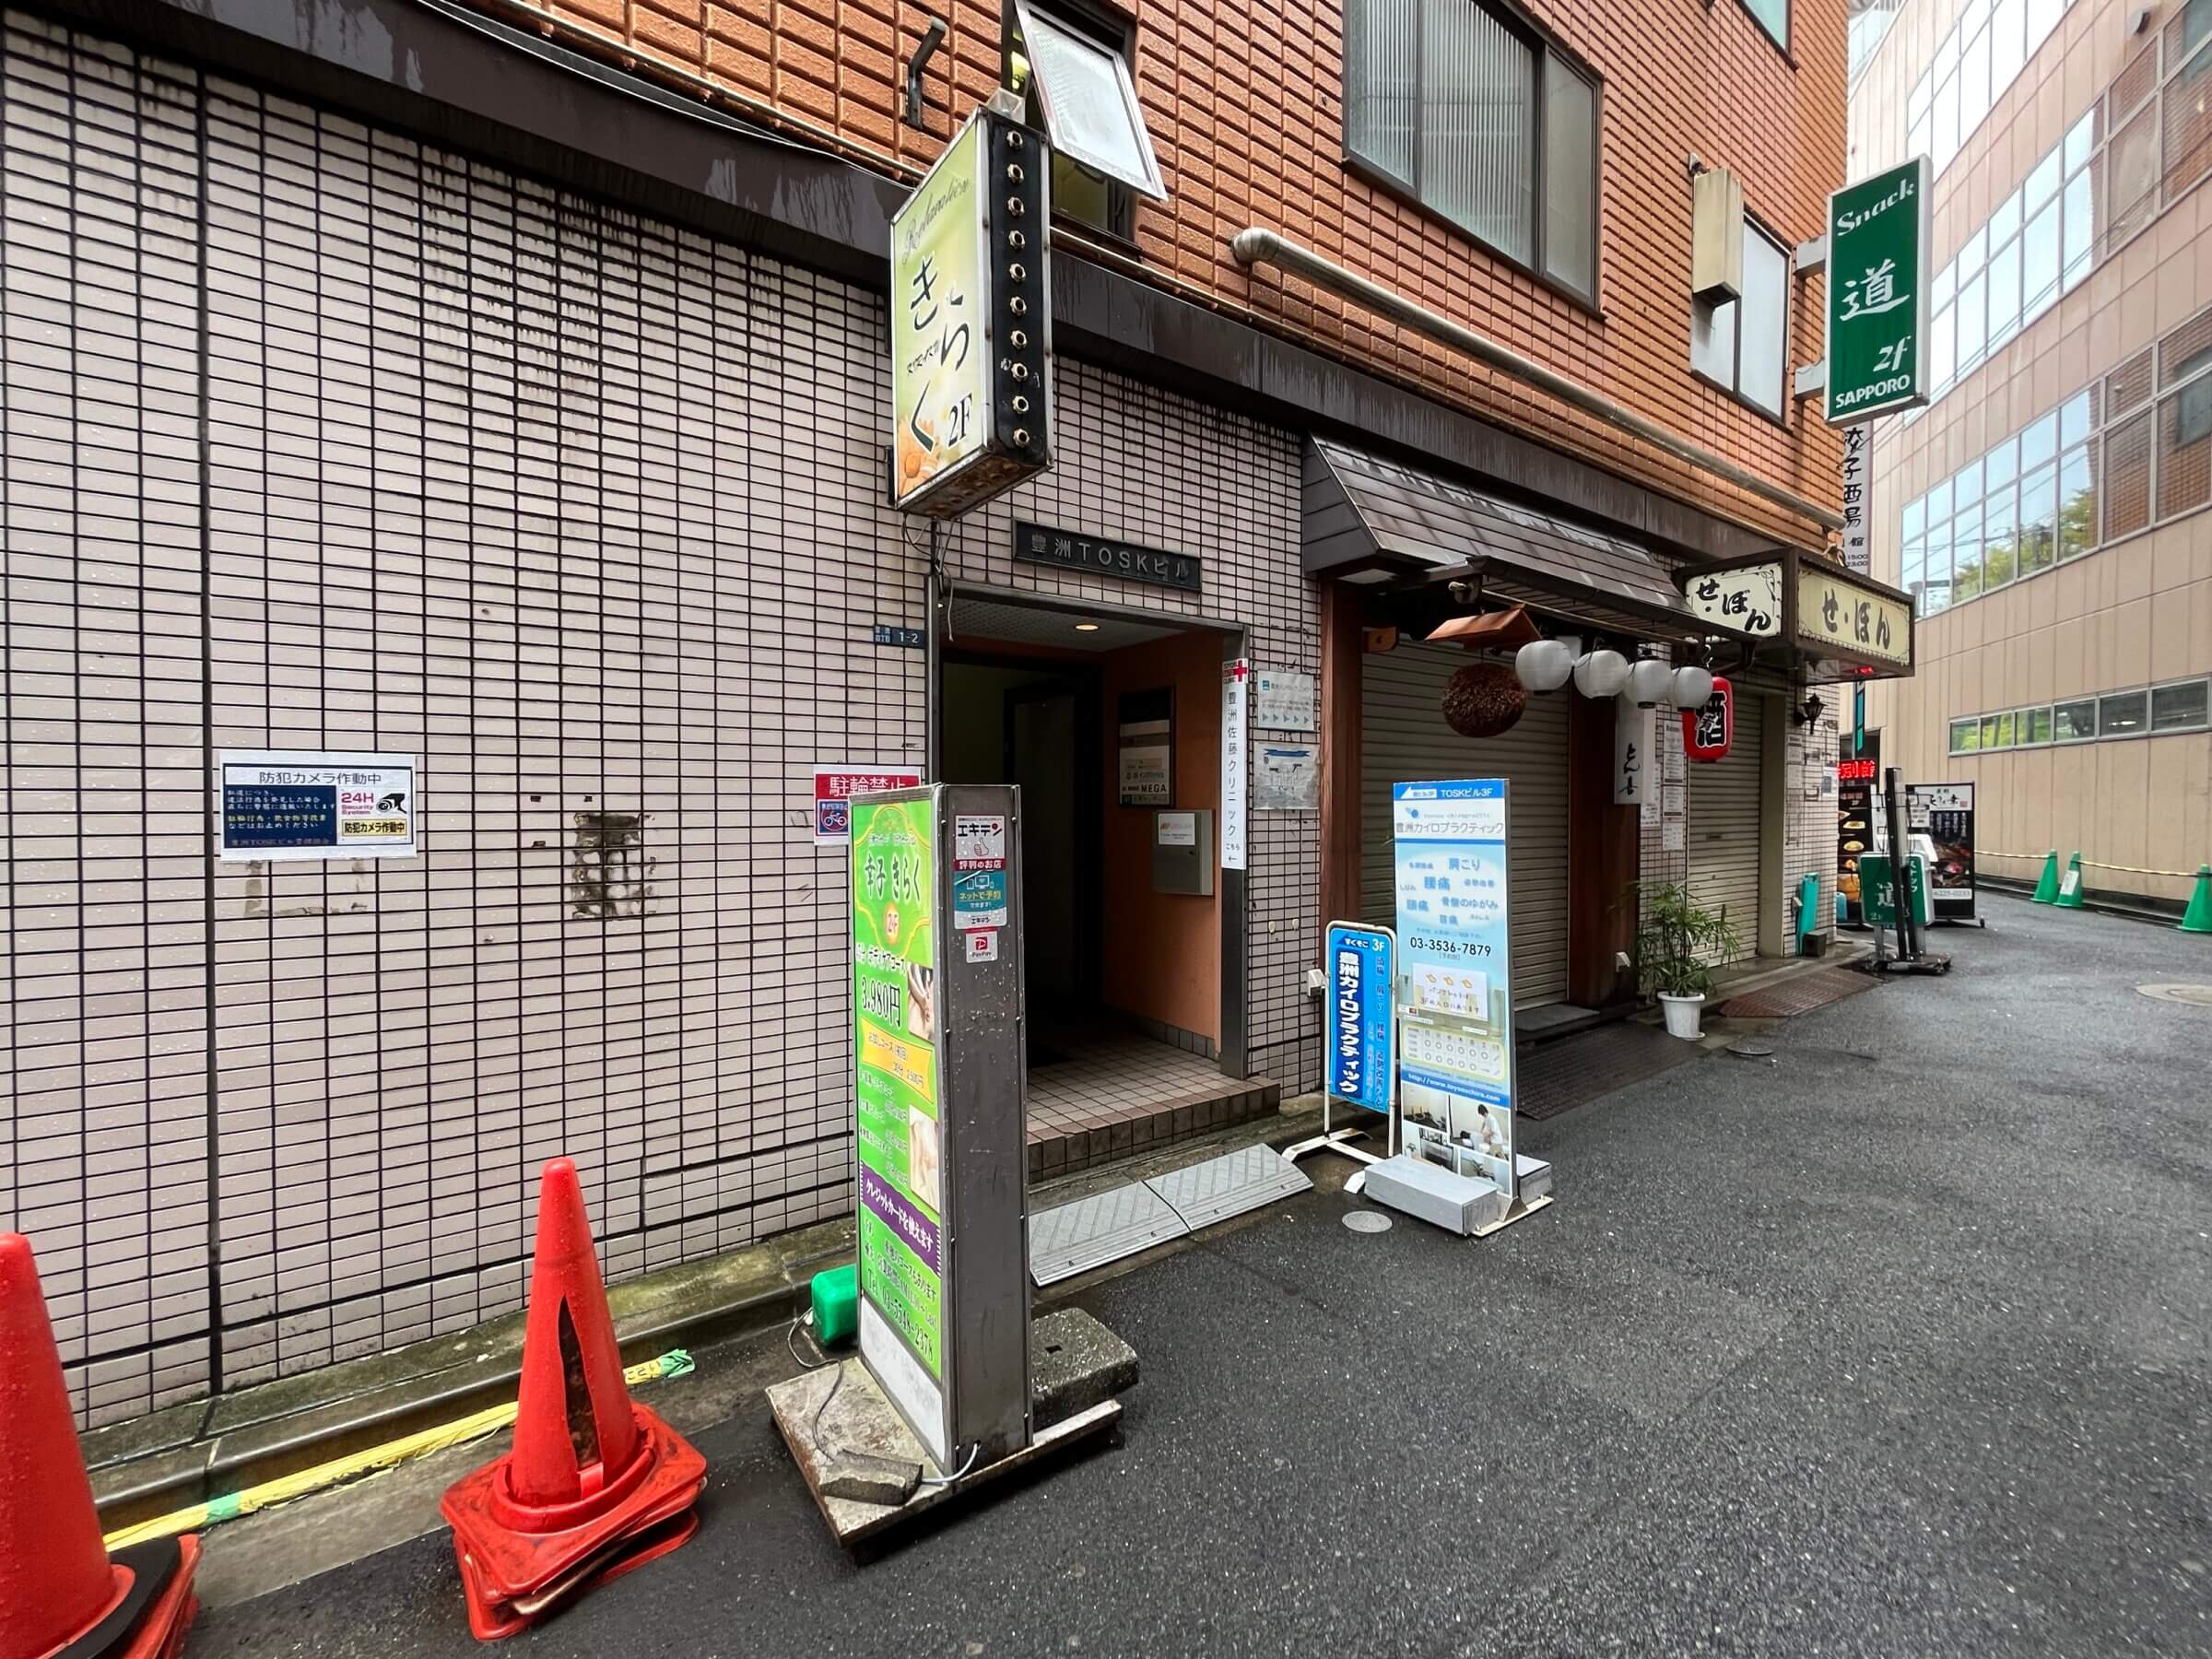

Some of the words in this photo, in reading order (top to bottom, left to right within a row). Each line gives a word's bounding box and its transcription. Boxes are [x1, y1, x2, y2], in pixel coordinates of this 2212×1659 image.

[1837, 178, 1914, 238] Snack
[1840, 258, 1910, 322] 道
[1835, 374, 1911, 408] SAPPORO
[948, 393, 972, 447] 2F
[899, 631, 918, 643] 1-2
[1227, 692, 1239, 837] 豊洲佐藤クリニック
[258, 771, 382, 784] 防犯カメラ作動中
[830, 776, 906, 797] 駐輪禁止
[1141, 783, 1167, 793] MEGA
[1440, 787, 1493, 798] TOSKビル3F
[341, 793, 374, 803] 24H
[344, 822, 406, 833] 防犯カメラ作動中
[958, 822, 1003, 837] エキテン
[1395, 822, 1504, 834] 豊洲カイロプラクティック
[1372, 938, 1385, 952] 3F
[1410, 936, 1491, 957] 03-3536-7879
[1338, 951, 1361, 1093] 豊洲カイロプラクティック
